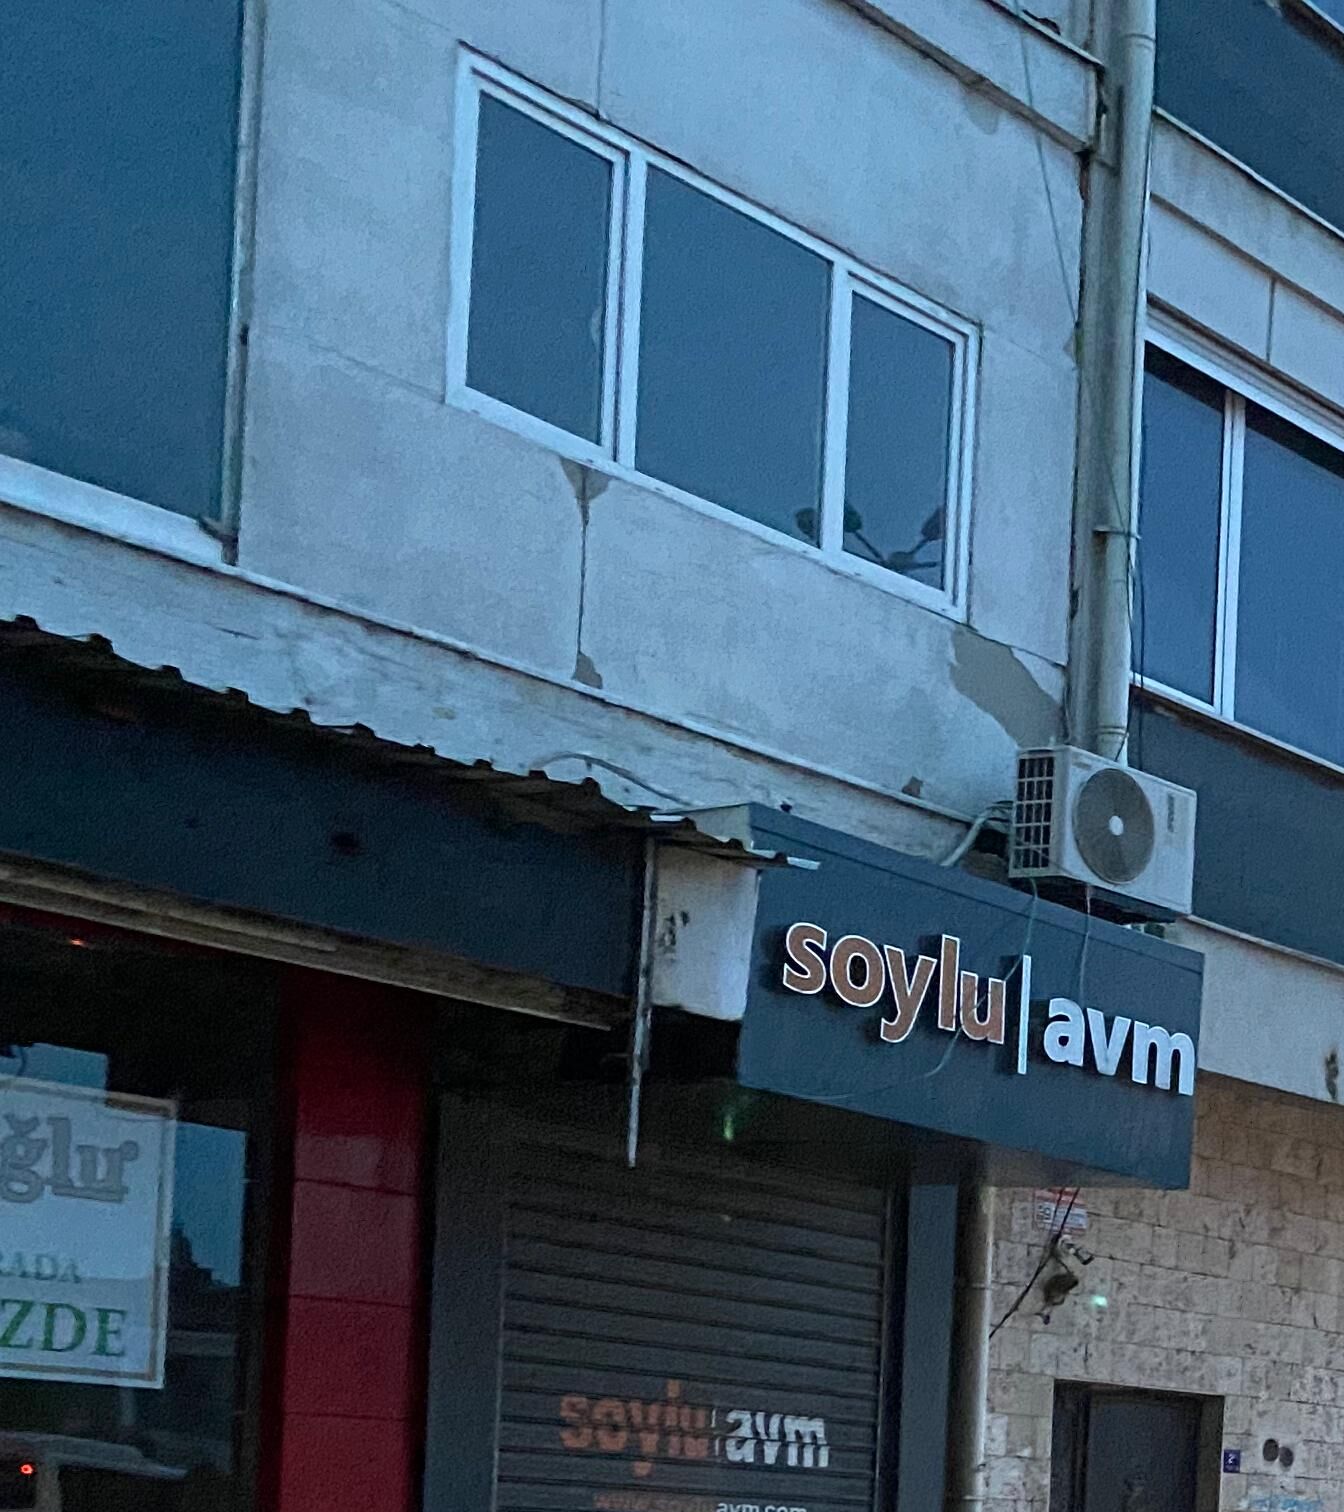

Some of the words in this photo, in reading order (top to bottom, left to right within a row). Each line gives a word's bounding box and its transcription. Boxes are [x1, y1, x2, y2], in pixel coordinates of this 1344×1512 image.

[781, 920, 1007, 1045] soylu
[1043, 996, 1195, 1097] avm
[559, 1378, 711, 1478] soylu
[724, 1408, 831, 1469] avm
